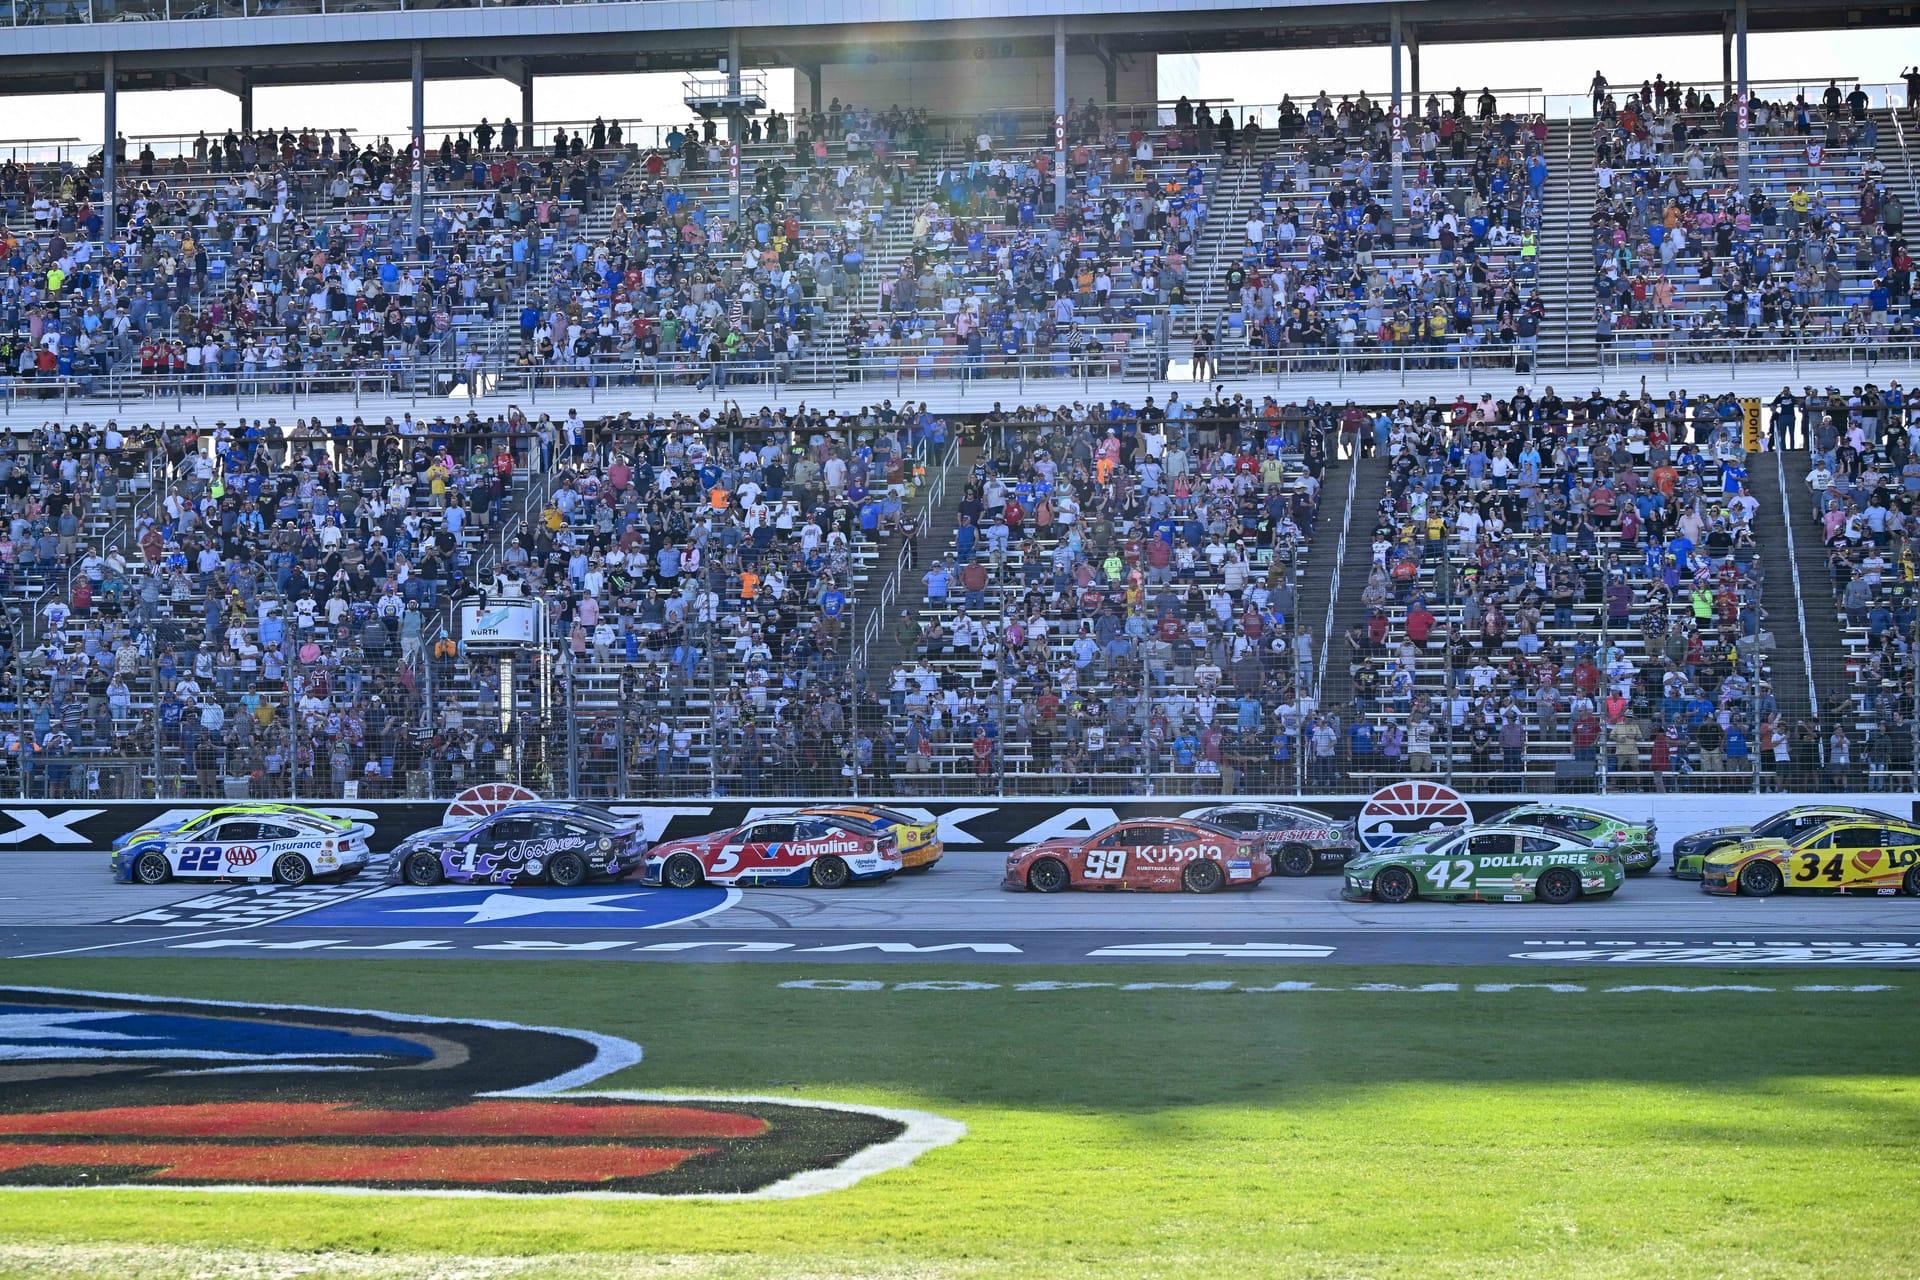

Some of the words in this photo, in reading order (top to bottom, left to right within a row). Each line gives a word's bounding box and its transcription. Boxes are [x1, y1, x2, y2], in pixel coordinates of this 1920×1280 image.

[1392, 105, 1401, 140] 402
[1738, 94, 1747, 129] 403
[1055, 115, 1064, 150] 401
[412, 137, 421, 170] 102
[730, 145, 739, 177] 101
[177, 846, 222, 871] 22
[229, 847, 254, 865] AAA
[272, 839, 322, 852] Insurance
[460, 843, 478, 872] 1
[710, 844, 744, 873] 5
[784, 839, 860, 857] Valvoline
[1135, 843, 1222, 863] Kubota
[1084, 849, 1128, 879] 99
[1426, 860, 1474, 888] 42
[1479, 855, 1544, 868] DOLLAR
[1548, 853, 1587, 865] TREE
[1795, 853, 1844, 882] 34
